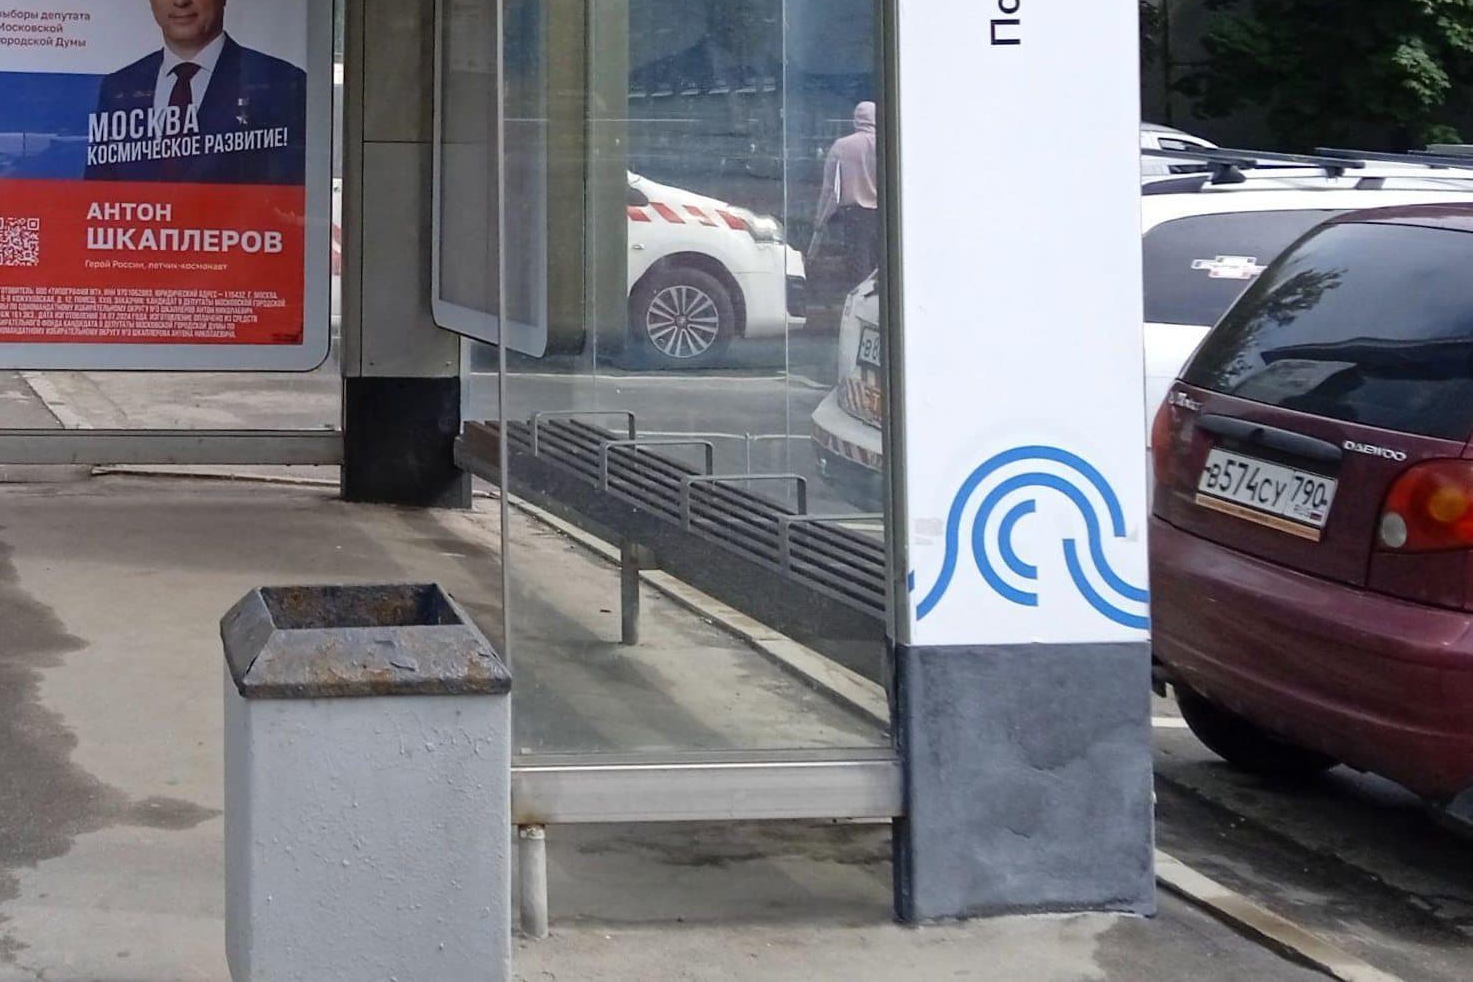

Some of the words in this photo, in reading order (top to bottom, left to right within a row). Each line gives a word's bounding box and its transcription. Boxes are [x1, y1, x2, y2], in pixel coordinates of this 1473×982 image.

[40, 11, 91, 22] депутата
[55, 37, 86, 49] Думы
[88, 103, 200, 144] МОСКВА
[87, 135, 201, 166] КОСМИЧЕСКОЕ
[205, 127, 289, 155] РАЗВИТИЕ!
[87, 202, 172, 222] АНТОН
[86, 226, 283, 254] ШКАПЛЕРОВ
[85, 259, 111, 270] Герой
[1343, 439, 1408, 462] DAEWOO
[1291, 475, 1328, 509] 790
